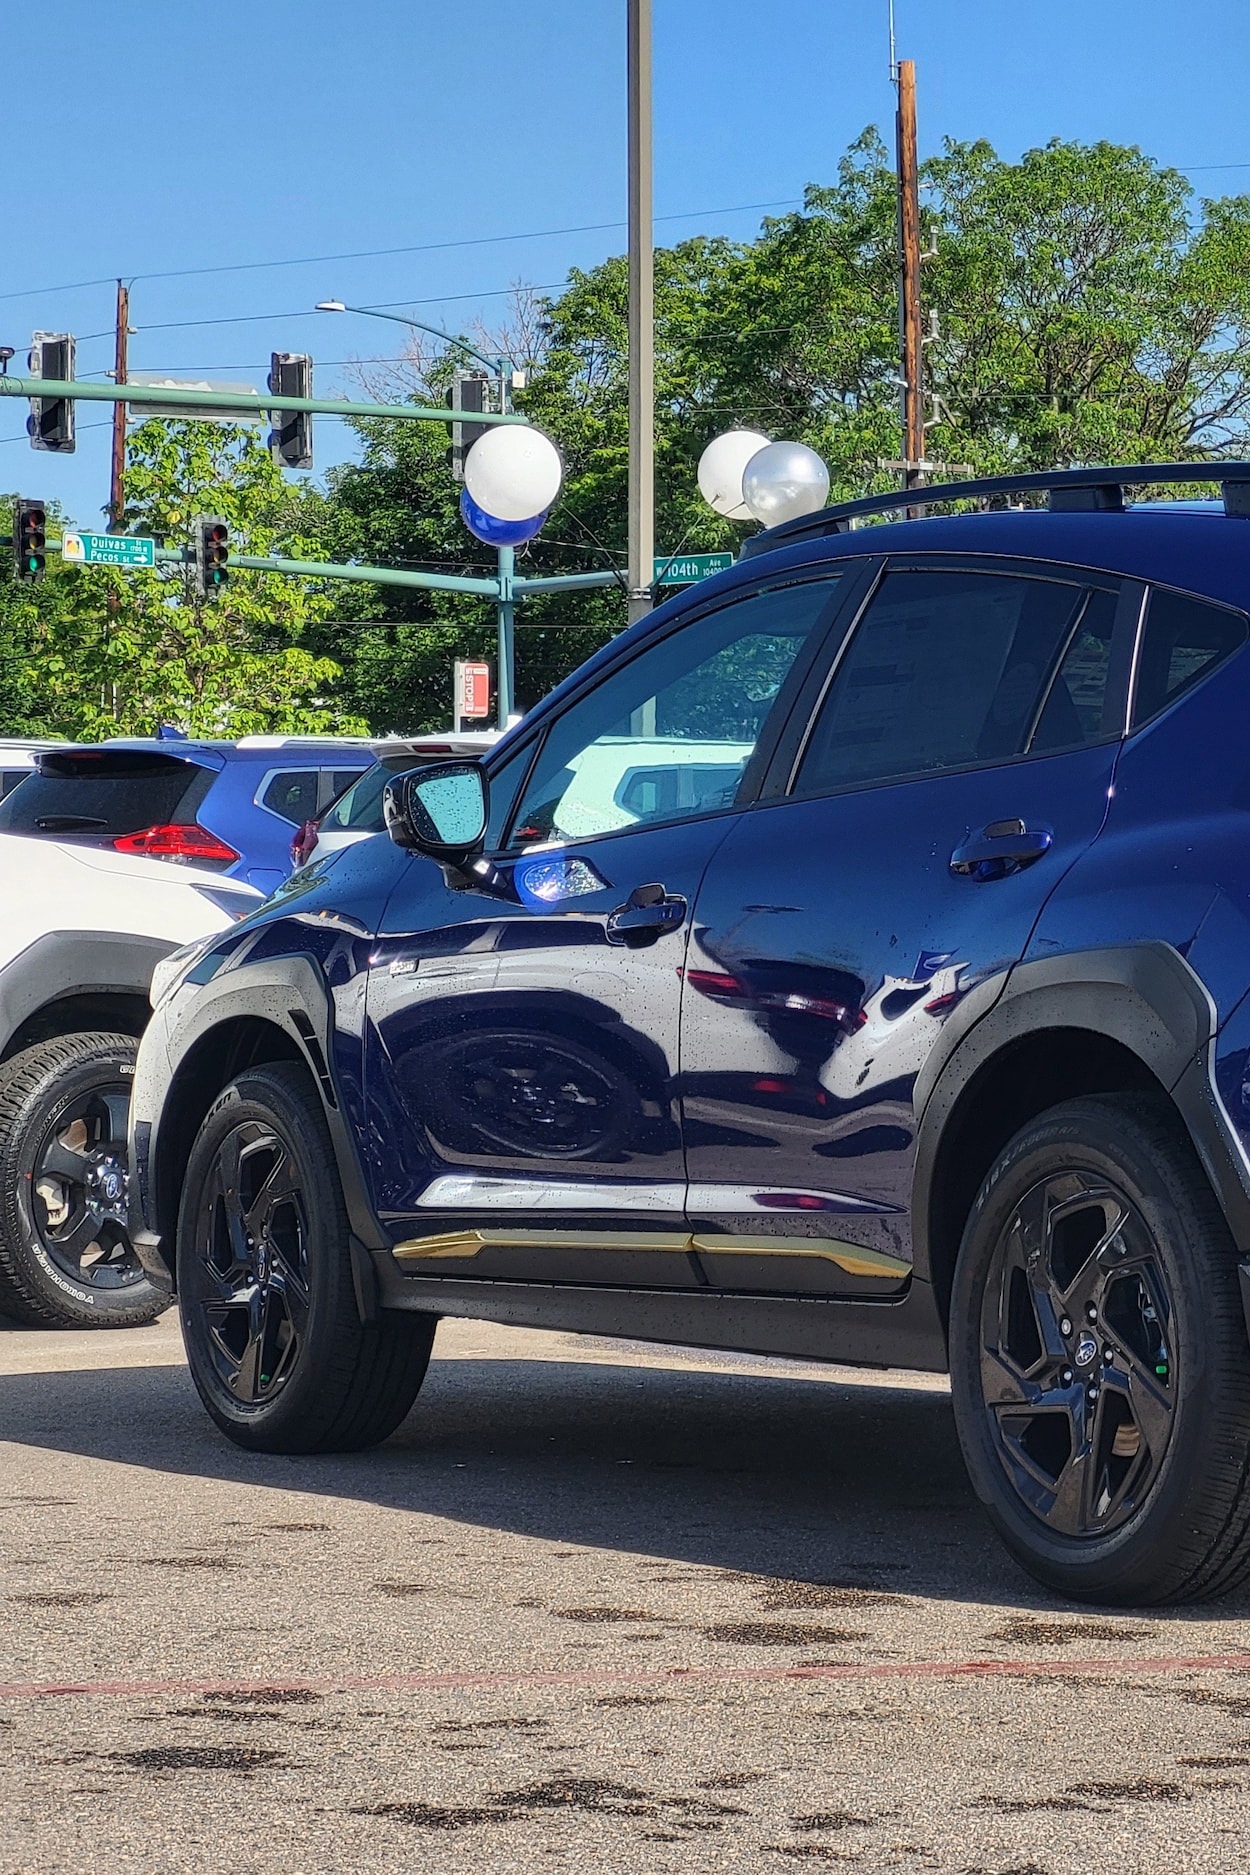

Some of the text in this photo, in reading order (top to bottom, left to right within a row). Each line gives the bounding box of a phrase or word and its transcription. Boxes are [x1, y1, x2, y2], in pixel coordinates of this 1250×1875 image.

[91, 536, 126, 550] Quivas
[91, 550, 119, 563] Pecos
[709, 559, 721, 567] Ave
[667, 562, 698, 577] 104th
[465, 674, 474, 702] STOP
[32, 1243, 95, 1305] YOKOHAMA
